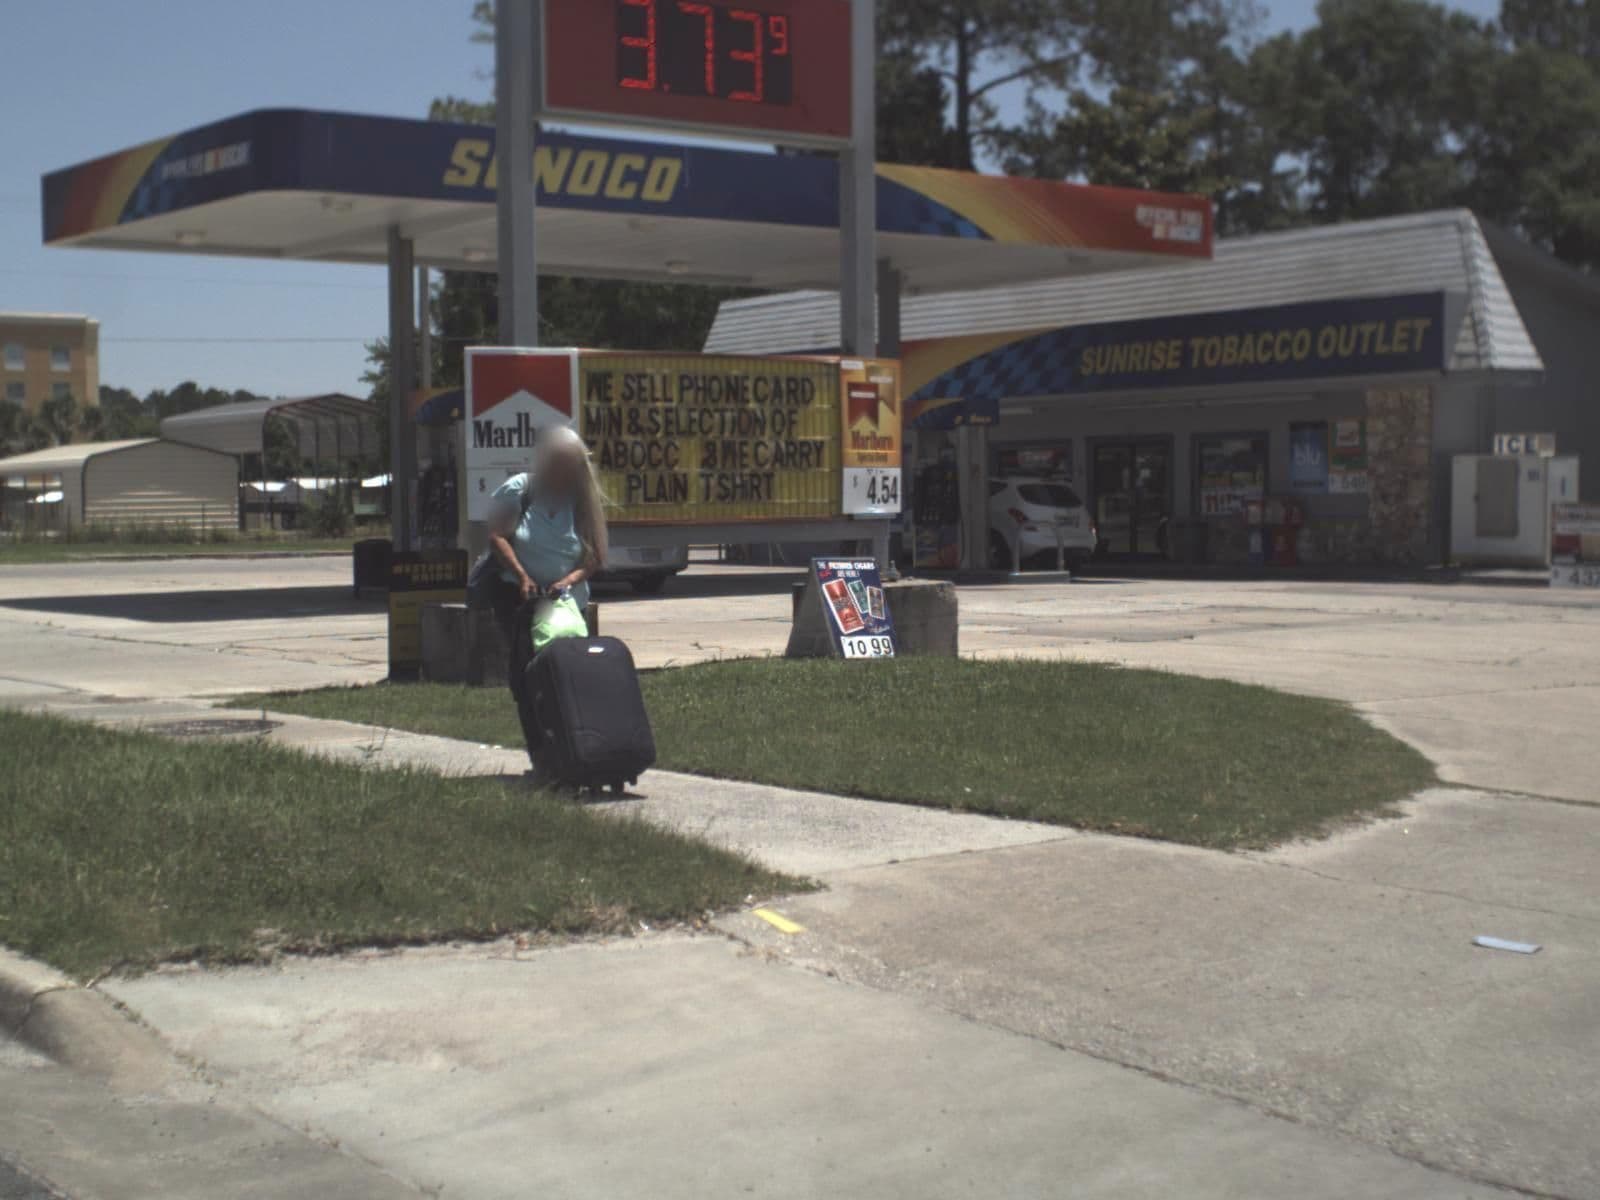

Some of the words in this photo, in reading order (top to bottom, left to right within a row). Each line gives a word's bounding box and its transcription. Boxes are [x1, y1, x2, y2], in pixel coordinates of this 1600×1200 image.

[442, 137, 683, 204] SNOCO
[1080, 338, 1181, 377] SUNRISE
[1189, 329, 1311, 369] TOBACCO
[1316, 317, 1432, 360] OUTLET
[586, 371, 614, 401] WE
[621, 371, 673, 402] SELL
[472, 412, 538, 449] Marlb
[771, 408, 799, 438] OF
[754, 440, 825, 470] CARRY
[866, 475, 900, 505] 4.54
